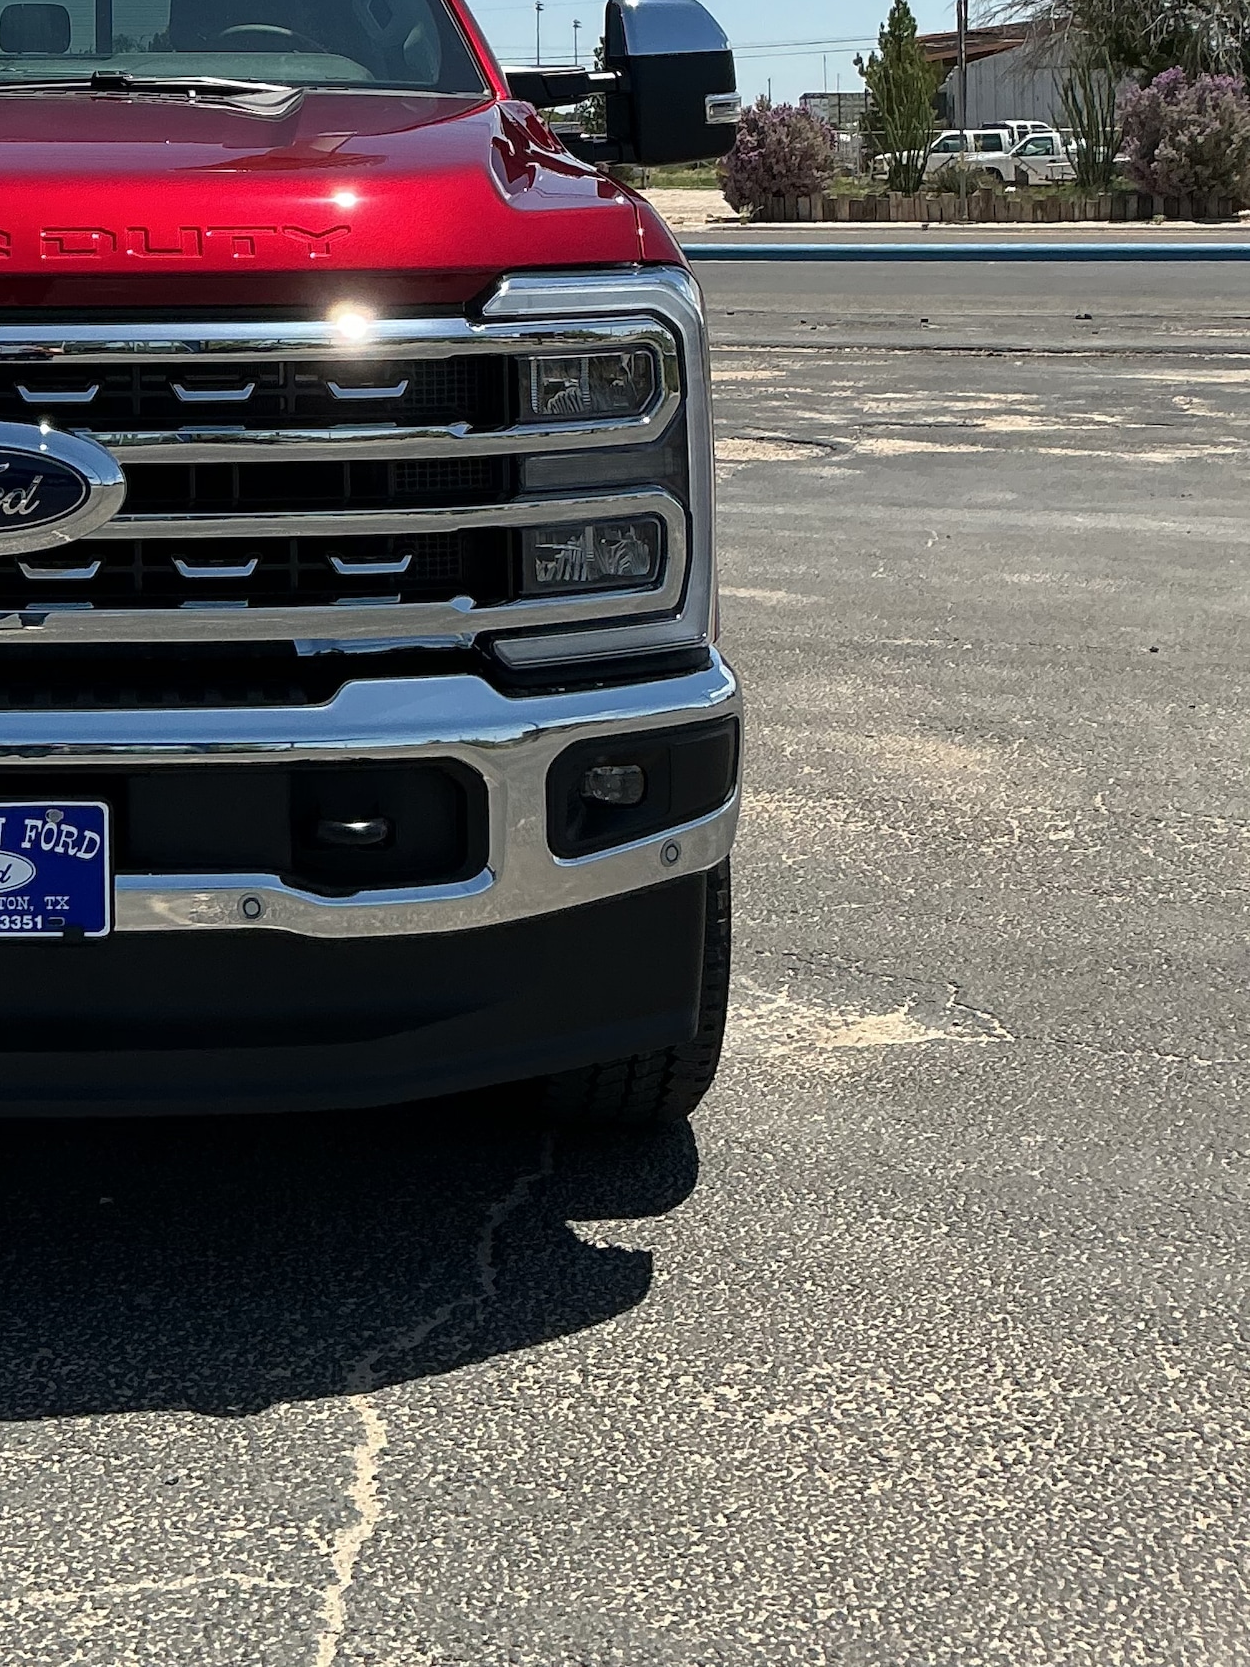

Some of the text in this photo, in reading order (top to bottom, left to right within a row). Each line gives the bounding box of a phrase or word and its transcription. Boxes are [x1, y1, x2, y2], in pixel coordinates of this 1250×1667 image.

[40, 225, 351, 260] DUTY
[21, 818, 101, 860] FORD
[44, 895, 70, 910] TX
